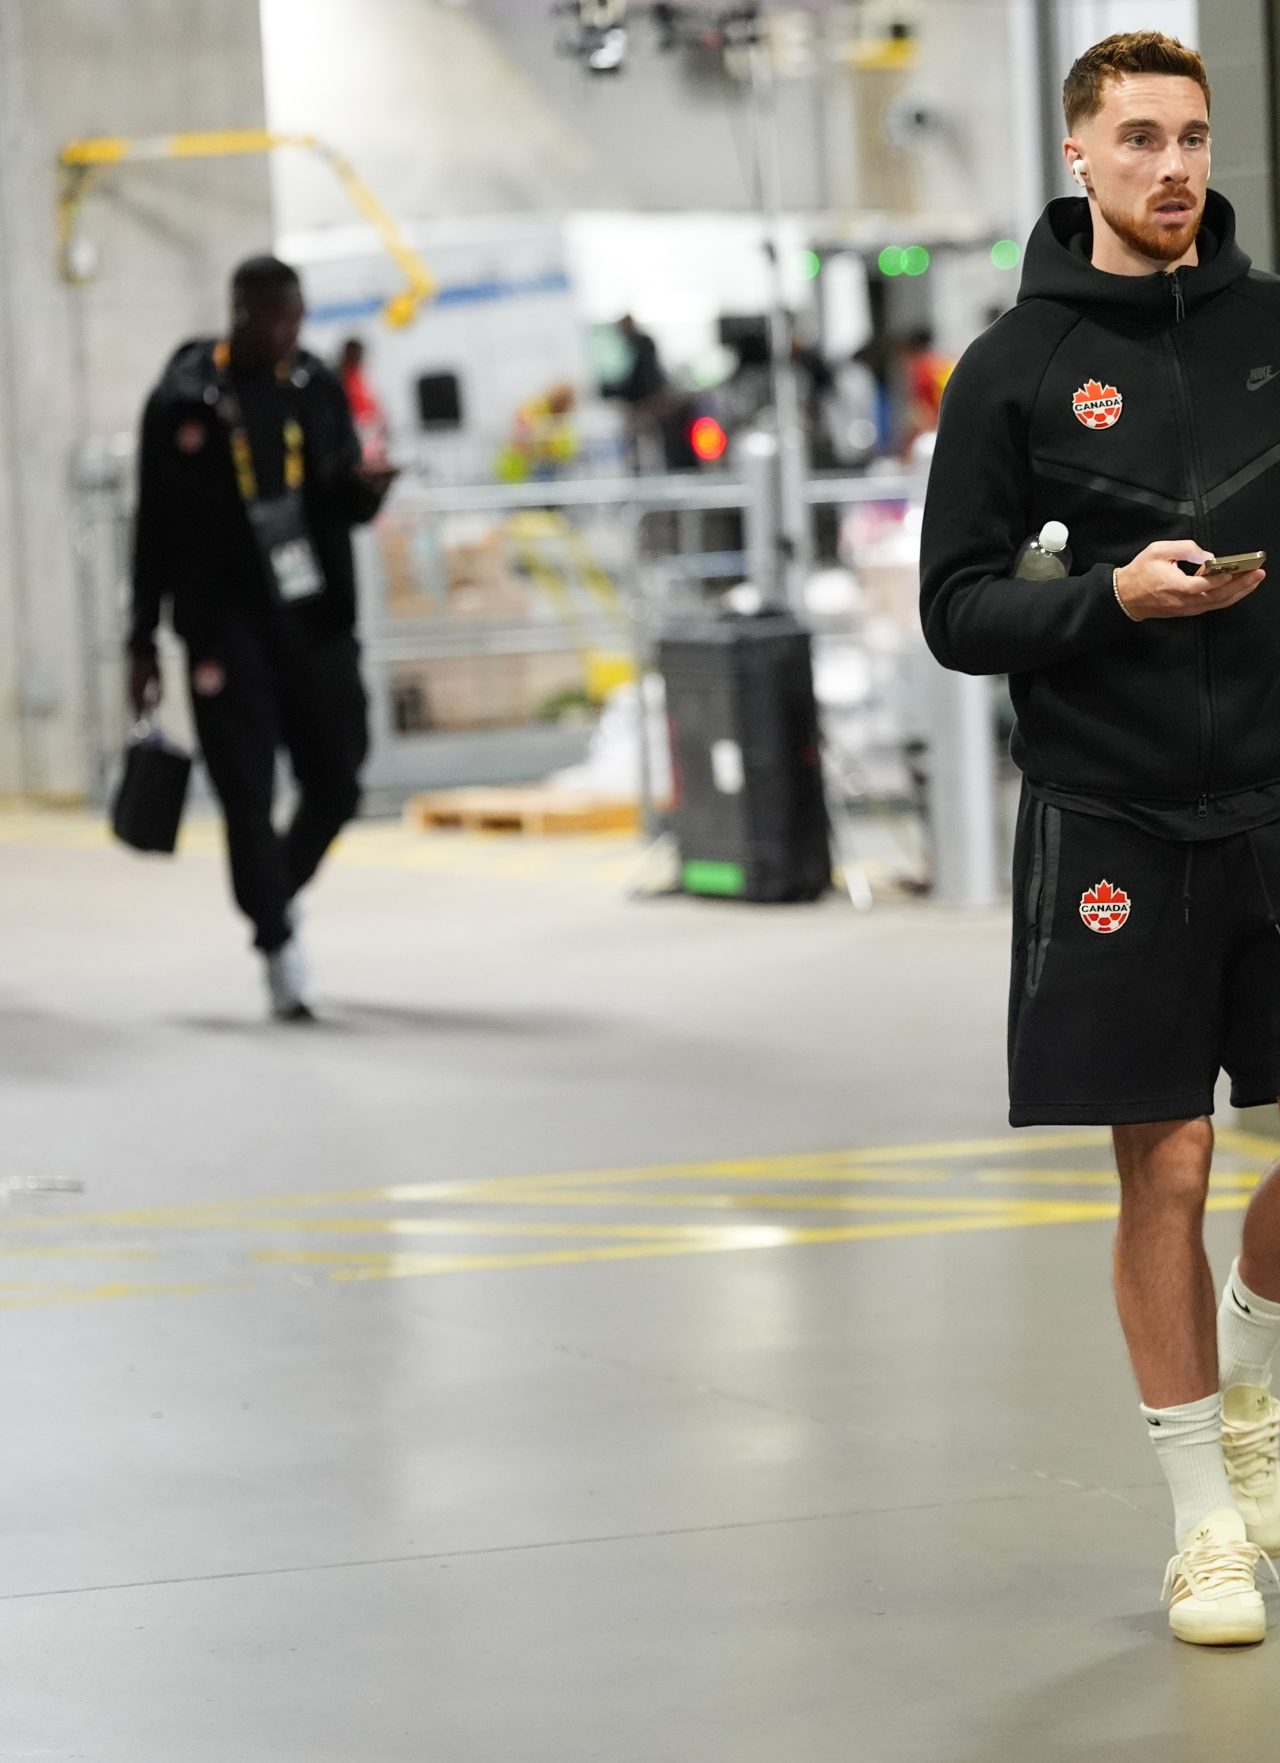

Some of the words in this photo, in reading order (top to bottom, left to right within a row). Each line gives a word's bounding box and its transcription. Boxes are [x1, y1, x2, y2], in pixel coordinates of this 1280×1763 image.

[1250, 365, 1272, 381] NIKE
[1075, 399, 1120, 411] CANADA
[1081, 904, 1128, 912] CANADA
